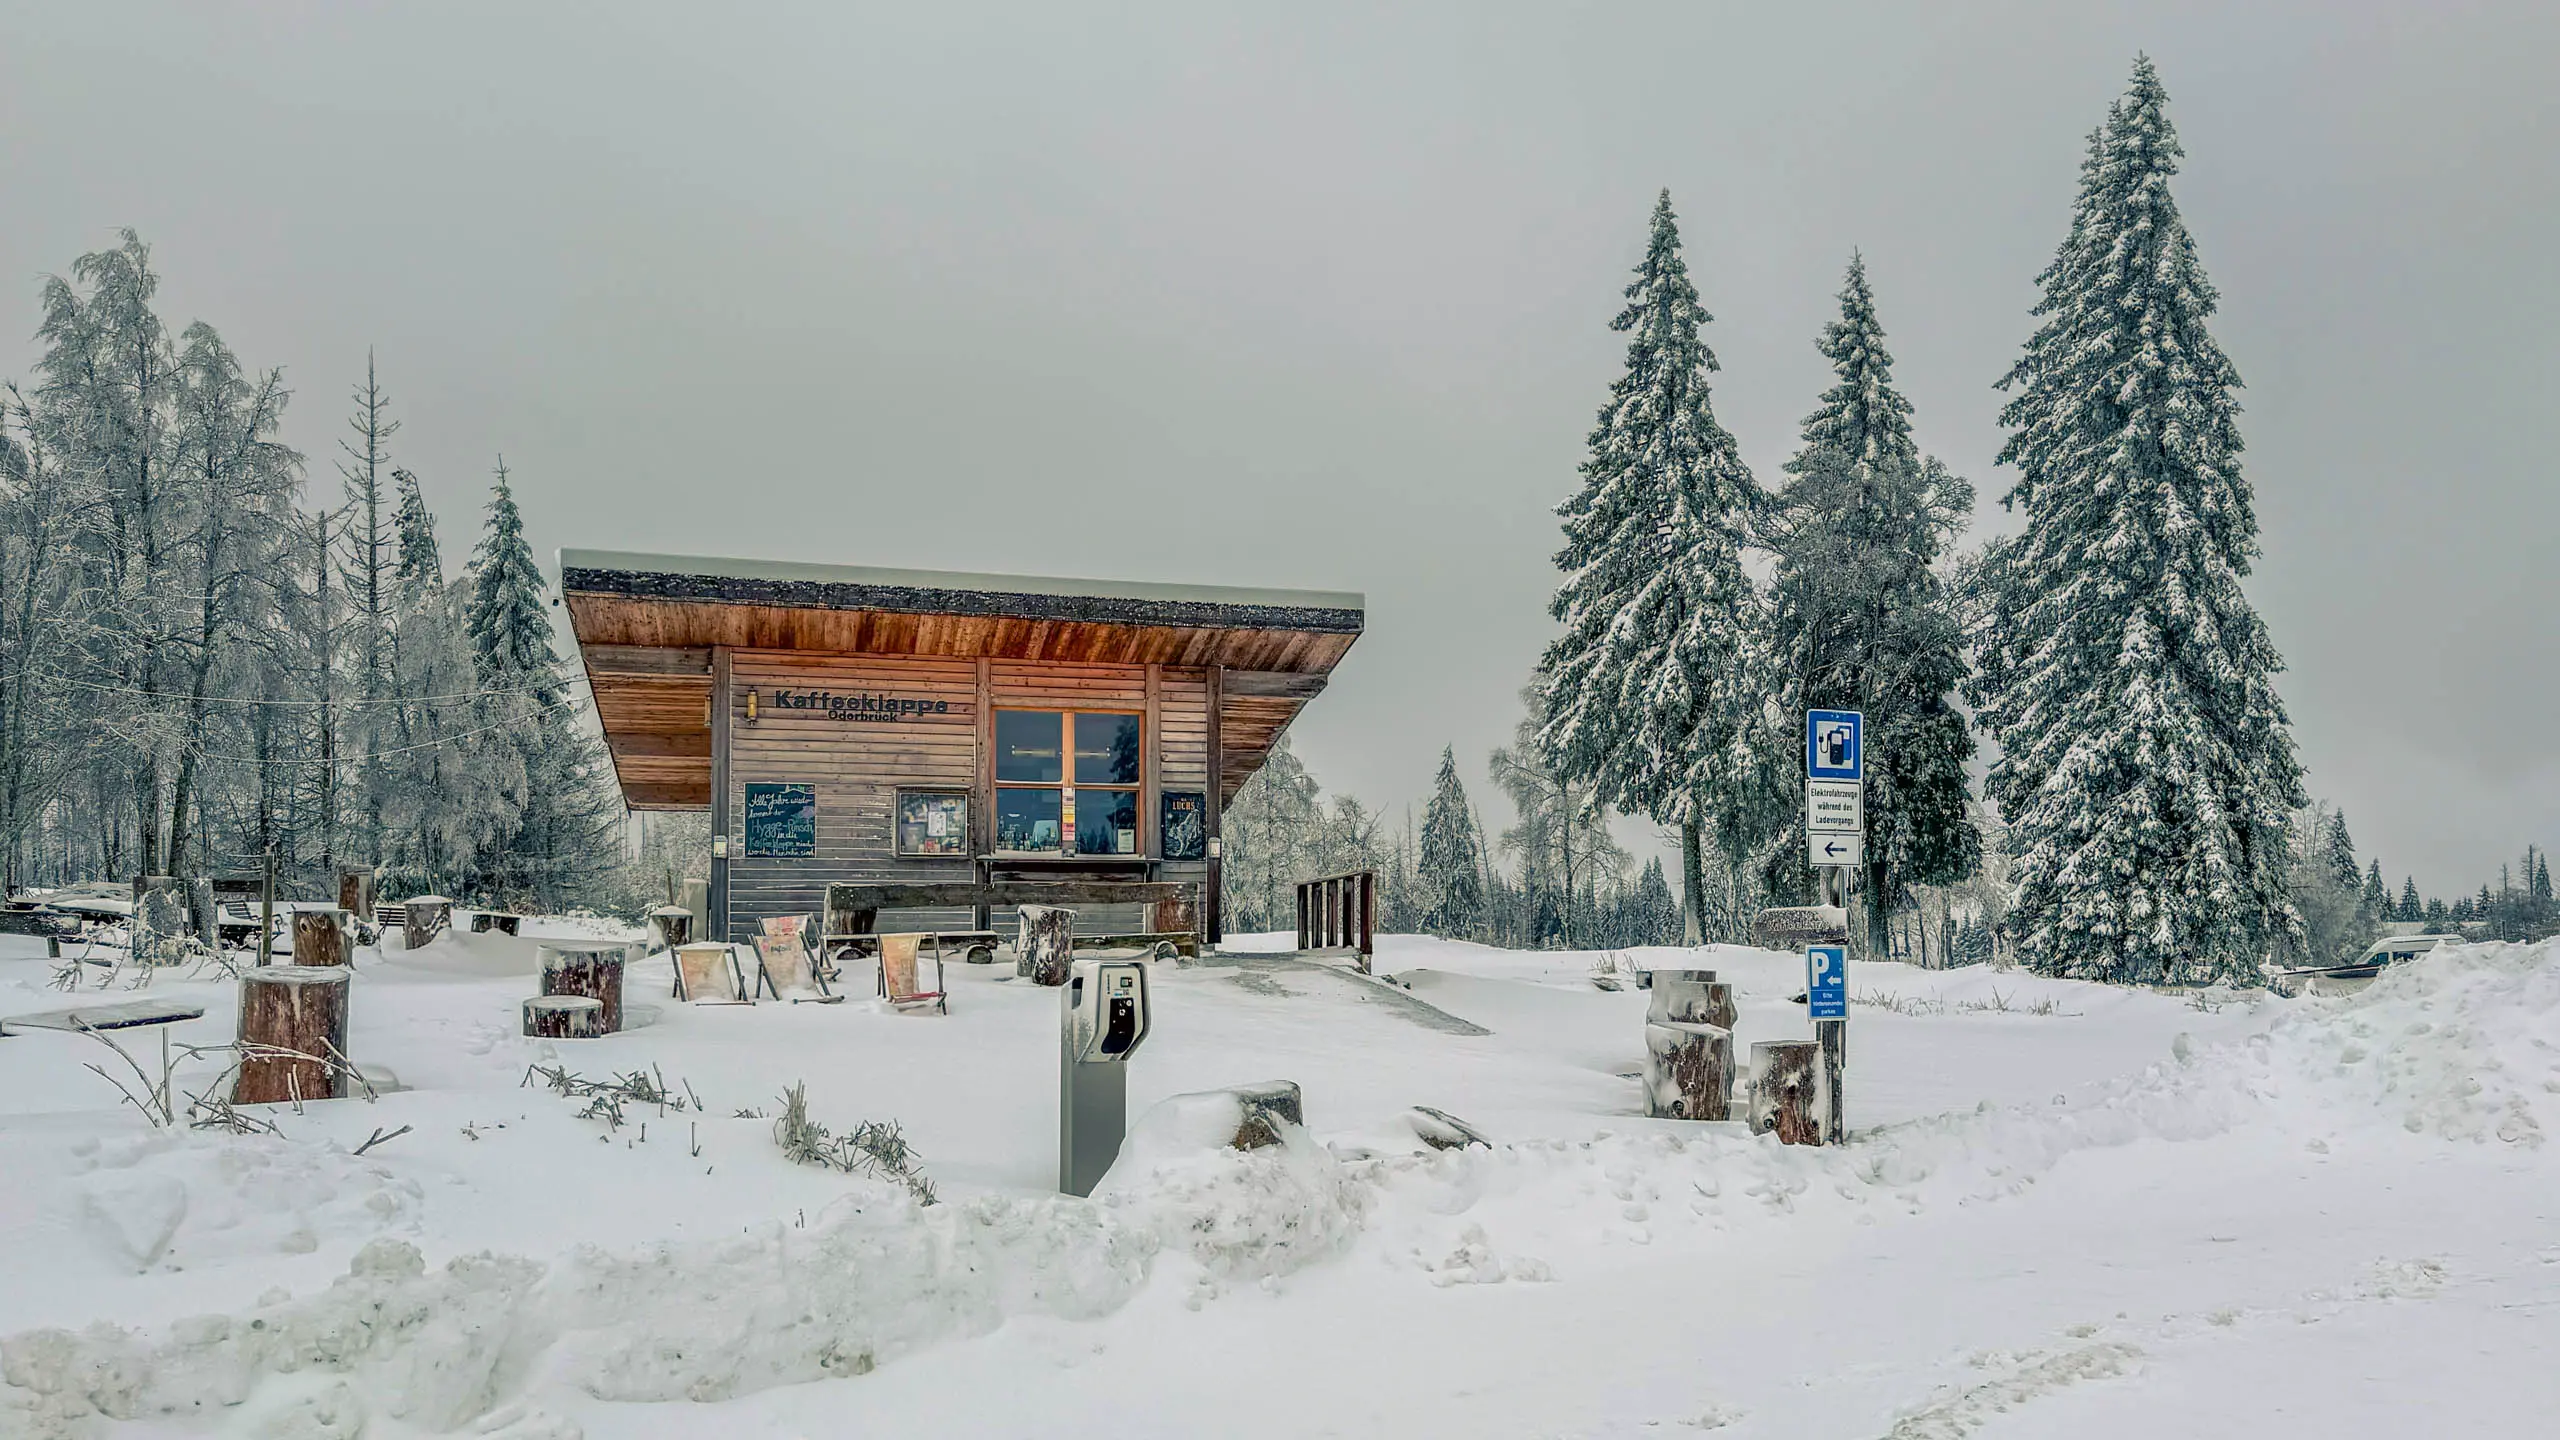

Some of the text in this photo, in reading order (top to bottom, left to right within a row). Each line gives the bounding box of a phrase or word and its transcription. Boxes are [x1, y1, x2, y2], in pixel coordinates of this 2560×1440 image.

[775, 690, 948, 716] Kaffeeklappe
[828, 710, 898, 723] Oderbrück
[1810, 788, 1858, 800] Elektrofahrzeuge
[1817, 802, 1841, 811] während
[1815, 815, 1854, 827] Ladevorgangs
[1811, 952, 1830, 987] P
